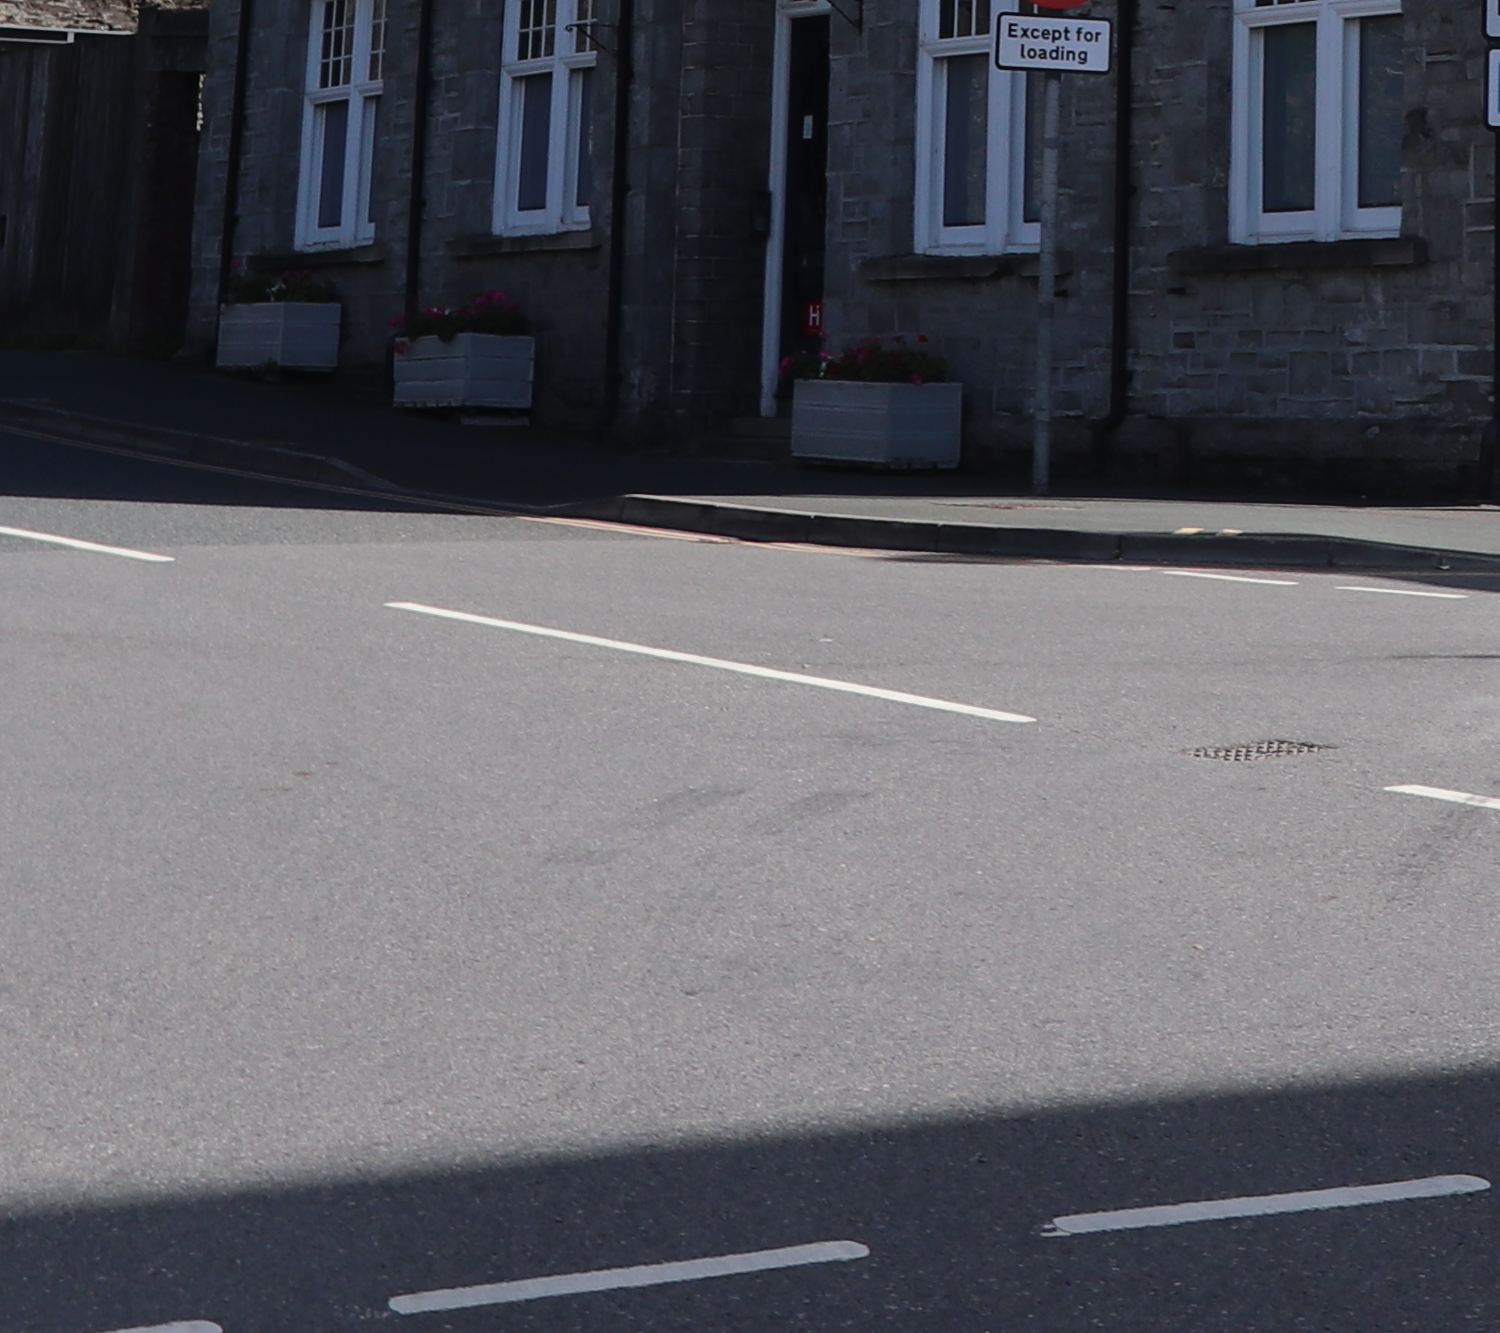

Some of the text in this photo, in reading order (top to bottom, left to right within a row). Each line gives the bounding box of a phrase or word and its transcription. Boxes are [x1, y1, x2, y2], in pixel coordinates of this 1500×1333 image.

[1007, 22, 1102, 44] Except for
[1020, 43, 1088, 65] loading
